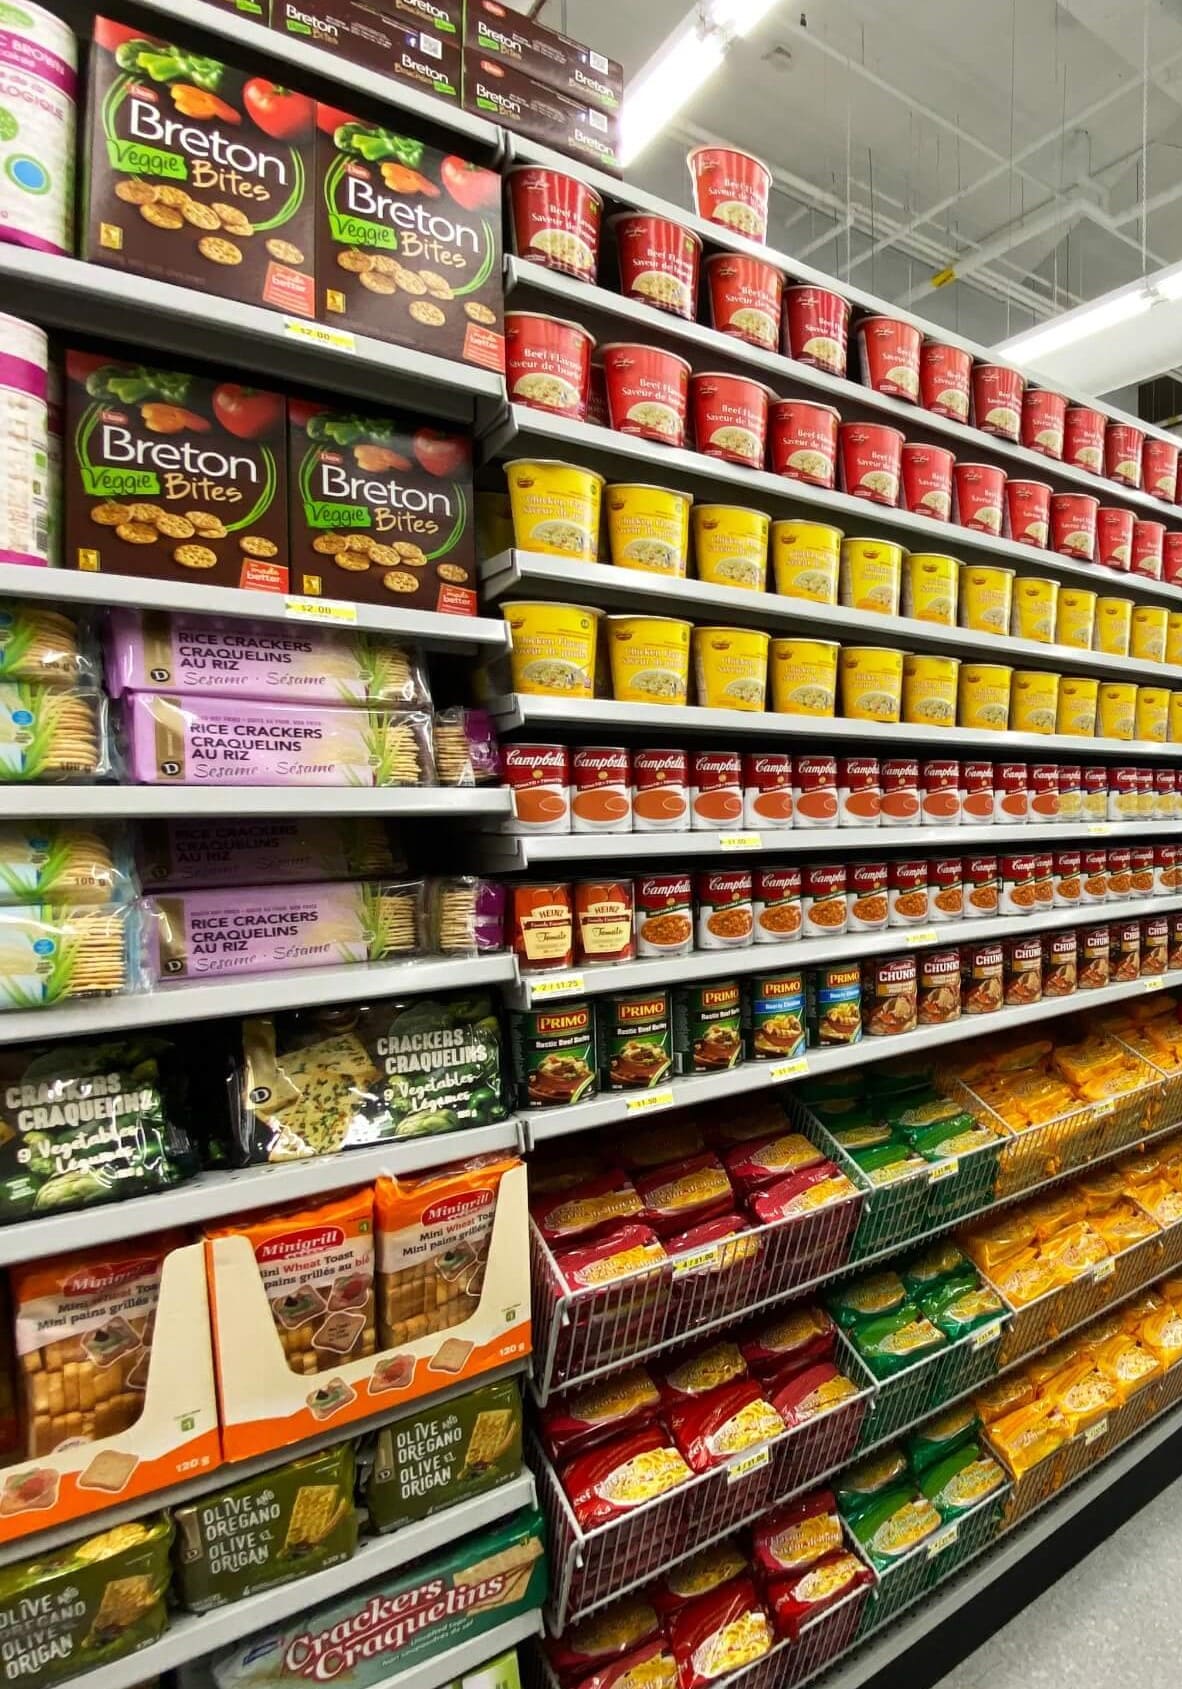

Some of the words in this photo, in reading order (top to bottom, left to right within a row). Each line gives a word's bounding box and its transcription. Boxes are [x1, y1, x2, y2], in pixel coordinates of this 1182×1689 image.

[286, 4, 338, 36] Breton
[478, 21, 523, 52] Breton
[12, 39, 66, 76] BROWN
[402, 53, 449, 84] Breton
[574, 70, 615, 98] Breton
[476, 83, 521, 114] Breton
[129, 99, 288, 187] Breton
[574, 128, 614, 156] Breton
[110, 140, 180, 176] Veggie
[191, 158, 272, 203] Bites
[347, 177, 480, 253] Breton
[333, 217, 392, 246] Veggie
[400, 232, 468, 269] Bites
[524, 349, 548, 360] Beef
[621, 386, 653, 398] Saveur
[640, 378, 661, 390] Beef
[706, 413, 734, 423] Saveur
[722, 404, 742, 415] Beef
[783, 437, 809, 447] Saveur
[797, 429, 815, 440] Beef
[101, 425, 259, 484] Breton
[84, 467, 154, 496] Veggie
[164, 472, 244, 504] Bites
[320, 464, 453, 518] Breton
[307, 502, 366, 530] Veggie
[374, 510, 441, 536] Bites
[178, 633, 219, 646] RICE
[223, 635, 313, 653] CRACKERS
[179, 647, 292, 663] CRAQUELINS
[181, 659, 206, 669] AU
[212, 660, 240, 671] RIZ
[183, 671, 249, 686] Sesame
[265, 671, 327, 686] Sésame
[190, 723, 229, 735] RICE
[234, 725, 322, 739] CRACKERS
[191, 737, 302, 751] CRAQUELINS
[192, 749, 217, 760] AU
[223, 750, 250, 761] RIZ
[194, 764, 259, 778] Sesame
[276, 761, 335, 775] Sésame
[191, 918, 228, 929] RICE
[233, 911, 319, 927] CRACKERS
[539, 909, 565, 919] HEINZ
[594, 906, 620, 914] HEINZ
[191, 926, 299, 943] CRAQUELINS
[192, 943, 217, 955] AU
[223, 940, 249, 953] RIZ
[195, 954, 258, 972] Sesame
[272, 942, 331, 960] Sésame
[765, 982, 801, 995] PRIMO
[830, 971, 861, 984] PRIMO
[621, 1001, 665, 1018] PRIMO
[704, 987, 739, 1005] PRIMO
[539, 1014, 588, 1031] PRIMO
[376, 1028, 465, 1056] CRACKERS
[385, 1044, 488, 1075] CRAQUELINS
[399, 1072, 484, 1099] Vegetables
[407, 1092, 473, 1115] Légumes
[17, 1148, 32, 1163] 9
[38, 1125, 138, 1158] Vegetables
[428, 1192, 491, 1221] Minigrill
[262, 1230, 339, 1258] Minigrill
[402, 1243, 427, 1257] Mini
[430, 1234, 458, 1250] pains
[458, 1223, 490, 1242] grillés
[419, 1228, 444, 1242] Mini
[445, 1218, 476, 1233] Wheat
[264, 1275, 298, 1291] pains
[299, 1268, 337, 1286] grillés
[337, 1261, 353, 1273] au
[355, 1253, 371, 1269] blé
[283, 1257, 321, 1274] Wheat
[323, 1250, 355, 1266] Toast
[37, 1316, 66, 1331] Mini
[70, 1307, 107, 1326] pains
[109, 1296, 150, 1316] grillés
[58, 1302, 90, 1314] Mini
[500, 1343, 518, 1357] 120
[396, 1420, 439, 1449] OLIVE
[397, 1427, 463, 1464] OREGANO
[175, 1459, 199, 1473] 120
[199, 1455, 211, 1467] g
[400, 1455, 441, 1484] OLIVE
[401, 1466, 451, 1499] ORIGAN
[203, 1496, 252, 1526] OLIVE
[206, 1504, 280, 1541] OREGANO
[209, 1532, 256, 1560] OLIVE
[211, 1546, 270, 1574] ORIGAN
[0, 1595, 52, 1630] OLIVE
[285, 1579, 443, 1672] Crackers
[315, 1575, 505, 1681] Craquelins
[1, 1627, 58, 1661] OLIVE
[5, 1634, 74, 1680] ORIGAN
